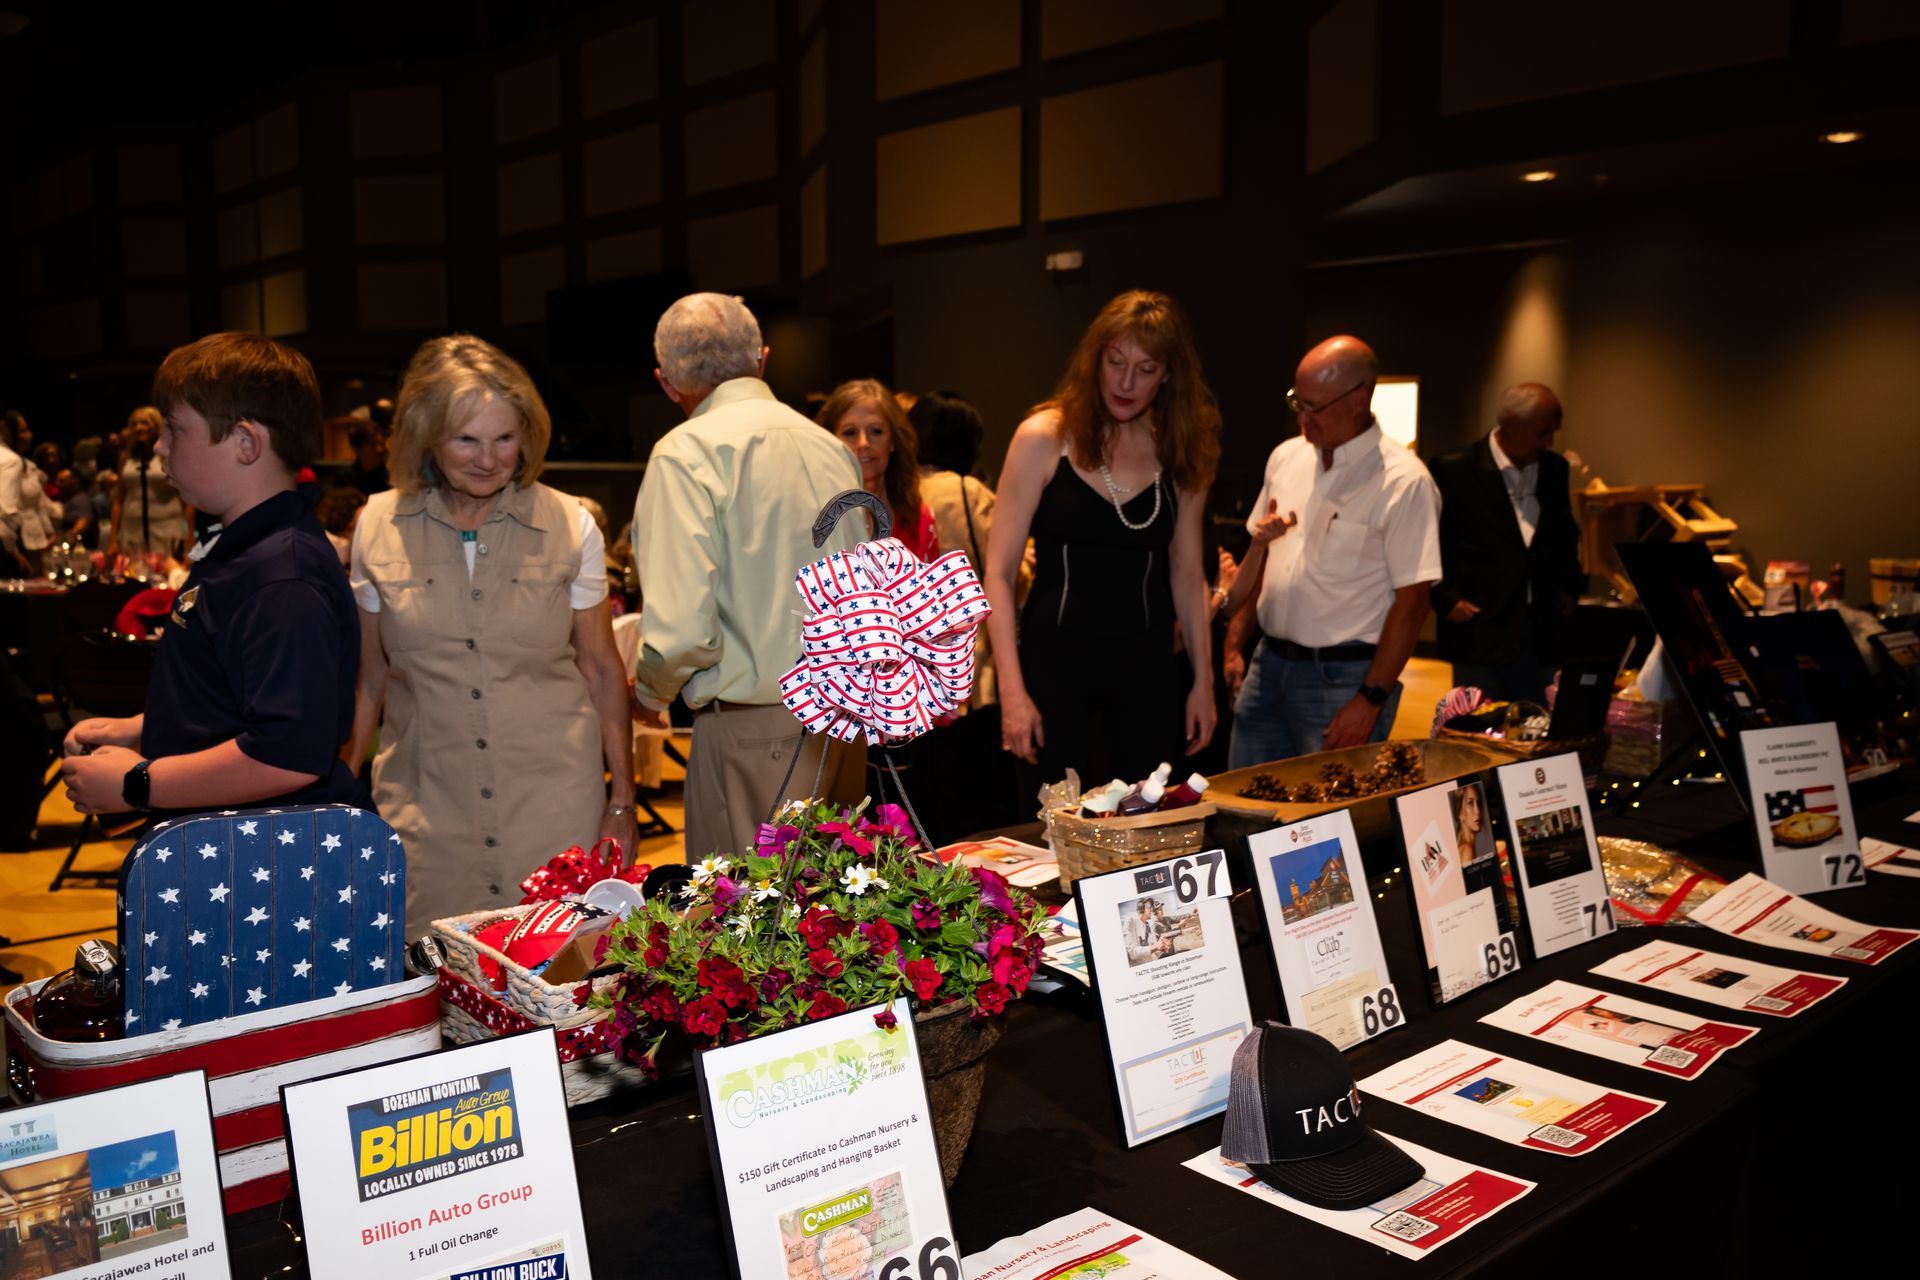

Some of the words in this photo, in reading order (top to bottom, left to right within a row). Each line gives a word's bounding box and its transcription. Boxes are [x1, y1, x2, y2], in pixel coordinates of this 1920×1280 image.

[1173, 851, 1223, 903] 67
[1825, 854, 1864, 886] 72
[1583, 898, 1615, 937] 71
[1316, 936, 1340, 956] Club
[1485, 937, 1516, 979] 69
[1363, 987, 1400, 1036] 68
[868, 1048, 895, 1061] Growing
[383, 1088, 430, 1113] BOZEMAN
[432, 1077, 480, 1100] MONTANA
[455, 1097, 479, 1113] Auto
[480, 1088, 510, 1106] Group
[726, 1060, 858, 1128] CASHMAN
[759, 1105, 789, 1119] Nursery
[801, 1087, 847, 1105] Landscaping
[1296, 1085, 1361, 1135] TACT
[11, 1144, 42, 1156] HOTEL
[360, 1105, 513, 1178] Billion
[738, 1168, 762, 1184] $150
[763, 1161, 780, 1175] Gift
[782, 1147, 826, 1168] Certificate
[828, 1143, 838, 1152] to
[839, 1129, 877, 1148] Cashman
[878, 1117, 910, 1135] Nursery
[911, 1114, 918, 1123] &
[365, 1172, 414, 1198] LOCALLY
[415, 1161, 456, 1184] OWNED
[457, 1153, 489, 1171] SINCE
[491, 1143, 519, 1162] 1978
[766, 1167, 820, 1193] Landscaping
[821, 1159, 837, 1173] and
[838, 1148, 873, 1167] Hanging
[873, 1138, 902, 1154] Basket
[361, 1217, 422, 1246] Billion
[428, 1202, 473, 1226] Auto
[477, 1184, 533, 1210] Group
[803, 1194, 868, 1232] CASHMAN
[154, 1250, 188, 1267] Hotel
[192, 1242, 215, 1257] and
[409, 1251, 415, 1261] 1
[419, 1243, 438, 1259] Full
[441, 1237, 457, 1251] Oil
[459, 1227, 499, 1245] Change
[994, 1249, 1038, 1272] Nursery
[1047, 1221, 1111, 1249] Landscaping
[162, 1272, 186, 1280] ill
[520, 1258, 558, 1280] BUCK
